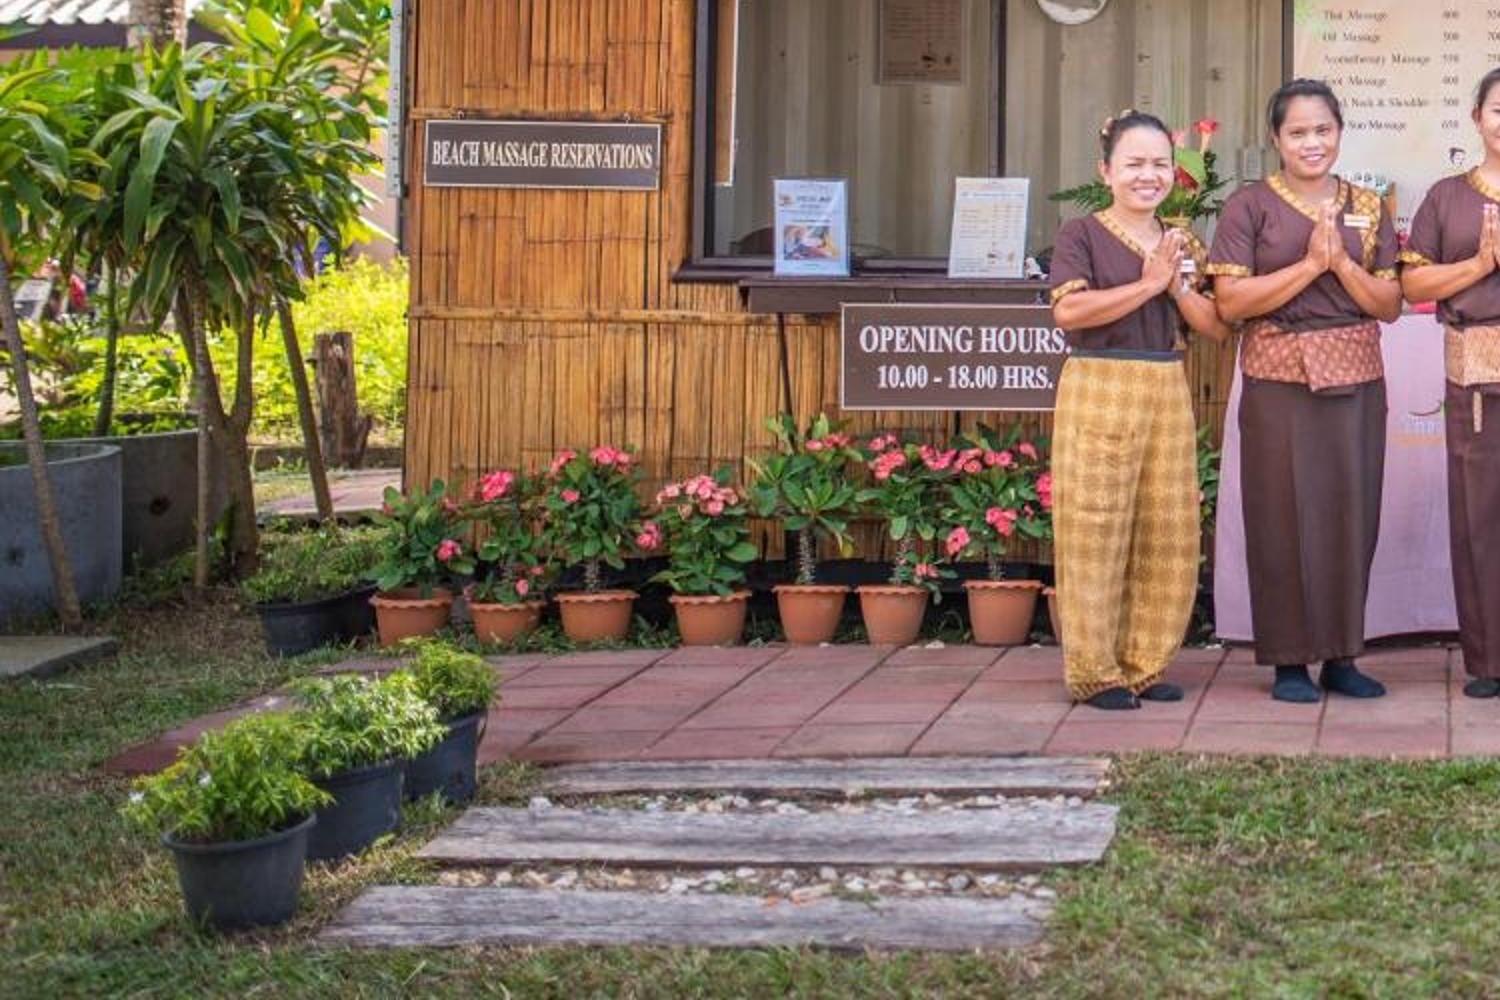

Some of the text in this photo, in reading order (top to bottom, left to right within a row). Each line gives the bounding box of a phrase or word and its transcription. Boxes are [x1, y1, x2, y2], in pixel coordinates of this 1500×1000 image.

[432, 140, 653, 169] BEACH MASSAGE RESERVATIONS
[859, 326, 974, 354] OPENING
[877, 364, 929, 389] 10.00
[947, 364, 998, 389] 18.00
[1001, 365, 1053, 390] HRS.
